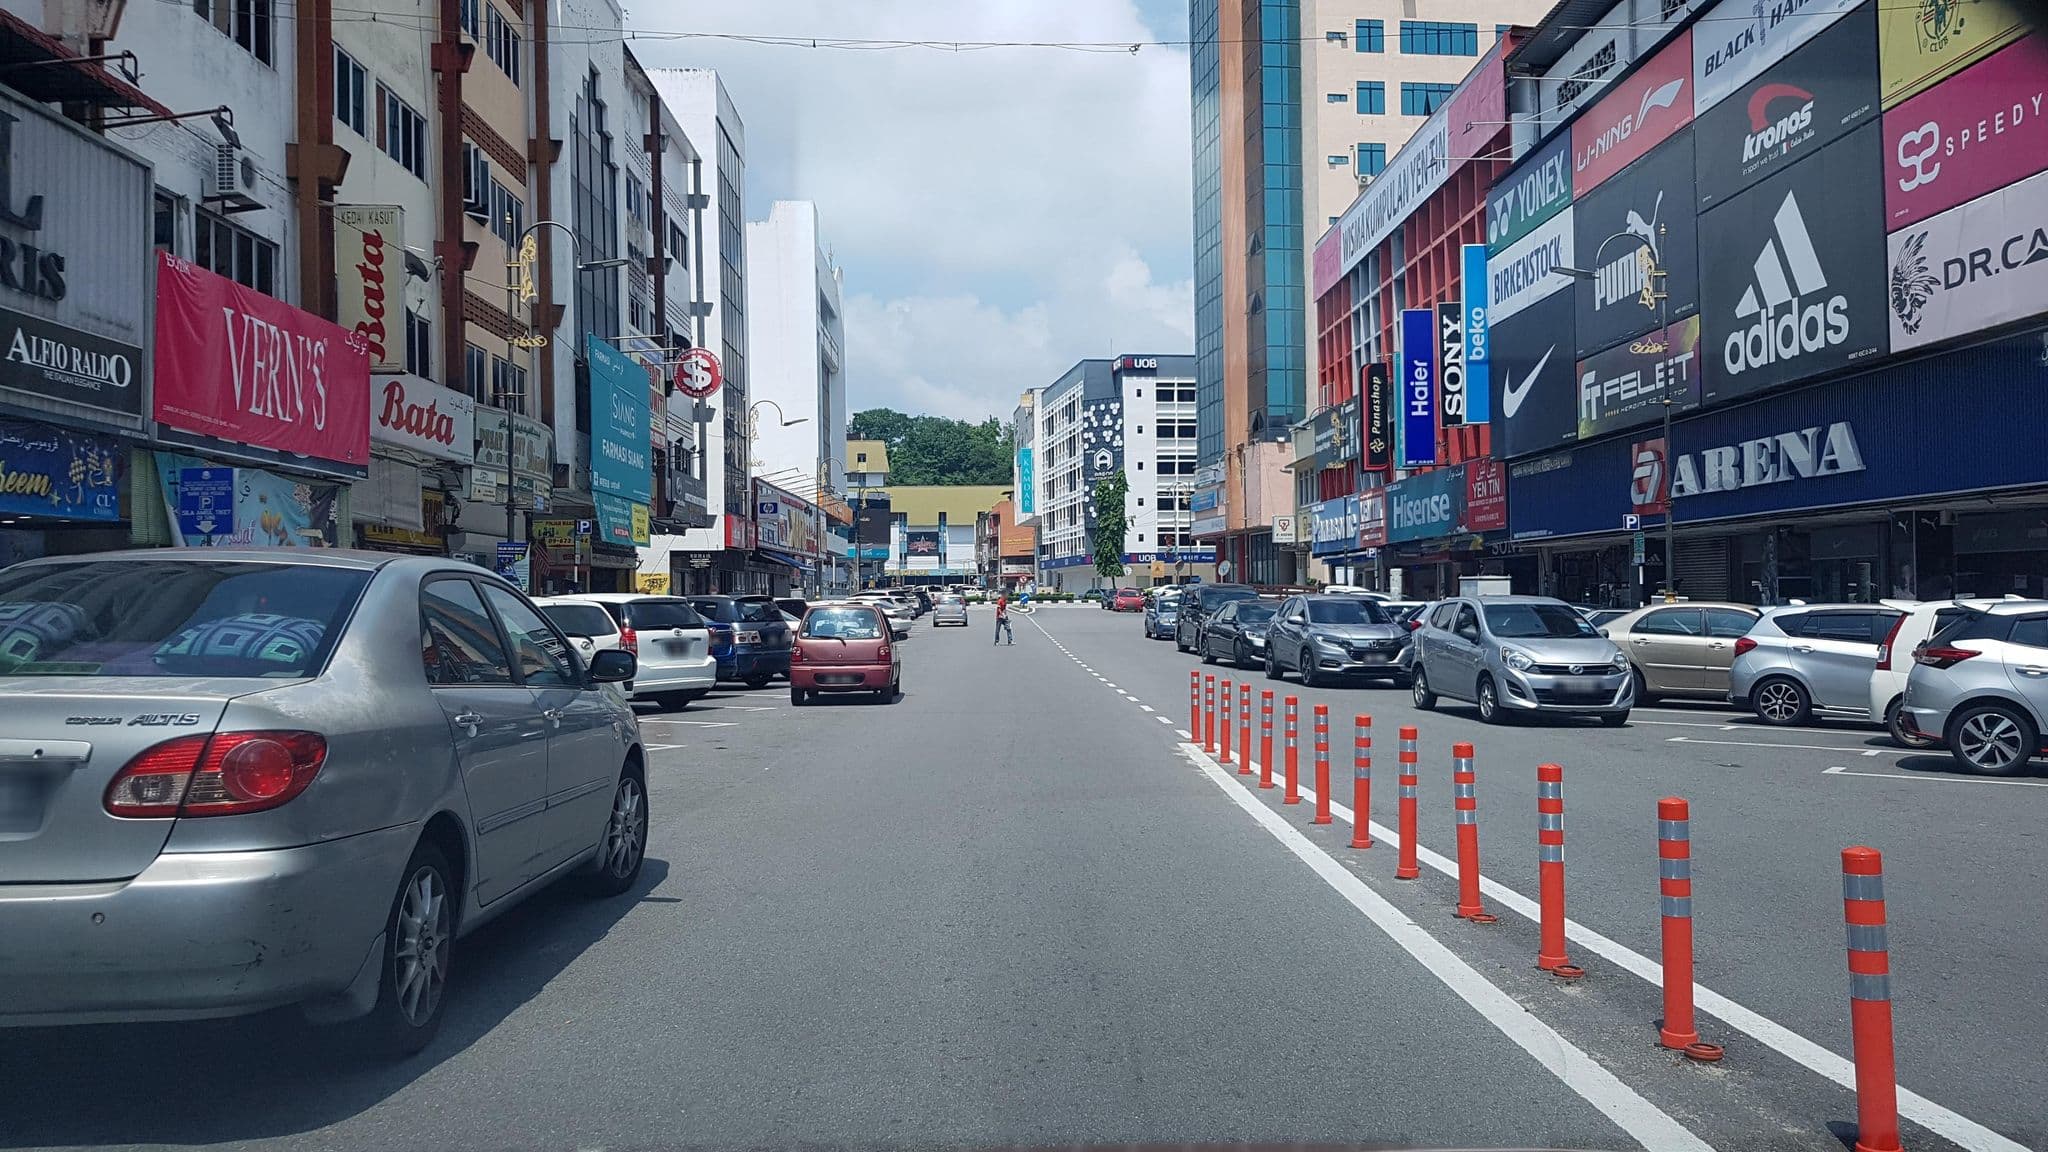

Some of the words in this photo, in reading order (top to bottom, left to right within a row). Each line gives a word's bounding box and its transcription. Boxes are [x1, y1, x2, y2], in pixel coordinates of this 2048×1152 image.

[1704, 24, 1755, 78] BLACK
[1929, 36, 1949, 53] CLUB
[1576, 114, 1632, 172] LI-NING
[1742, 100, 1814, 163] kronos
[1945, 93, 2043, 158] SPEEDY
[1341, 217, 1367, 264] WISMA
[1365, 168, 1410, 239] KUMPULAN
[1410, 151, 1429, 200] YEN
[1429, 127, 1447, 184] TIN
[1516, 149, 1566, 223] YONEX
[341, 211, 364, 225] KEDAI
[368, 211, 394, 225] KASUT
[354, 228, 386, 364] Bata
[1494, 234, 1561, 306] BIRKENSTOCK
[5, 327, 68, 370] ALFIO
[71, 346, 132, 387] RALDO
[1468, 306, 1485, 361] beko
[1724, 295, 1849, 375] adidas
[222, 306, 328, 432] VERN'S
[1134, 358, 1157, 369] UOB
[1410, 359, 1429, 416] Haier
[1443, 315, 1463, 416] SONY
[378, 380, 455, 446] Bata
[611, 393, 635, 428] SIANG
[1370, 376, 1382, 434] Panashop
[602, 438, 628, 465] FARMASI
[628, 451, 644, 470] SIANG
[1670, 421, 1867, 499] ARENA
[201, 497, 211, 509] P
[1022, 459, 1032, 508] KAMDAR
[1393, 493, 1450, 529] Hisense
[1472, 479, 1487, 499] YEN
[1487, 478, 1501, 496] TIN
[580, 520, 590, 533] P
[1626, 516, 1637, 529] P
[1138, 554, 1157, 562] UOB
[1368, 548, 1375, 557] P
[127, 712, 200, 727] ALTIS
